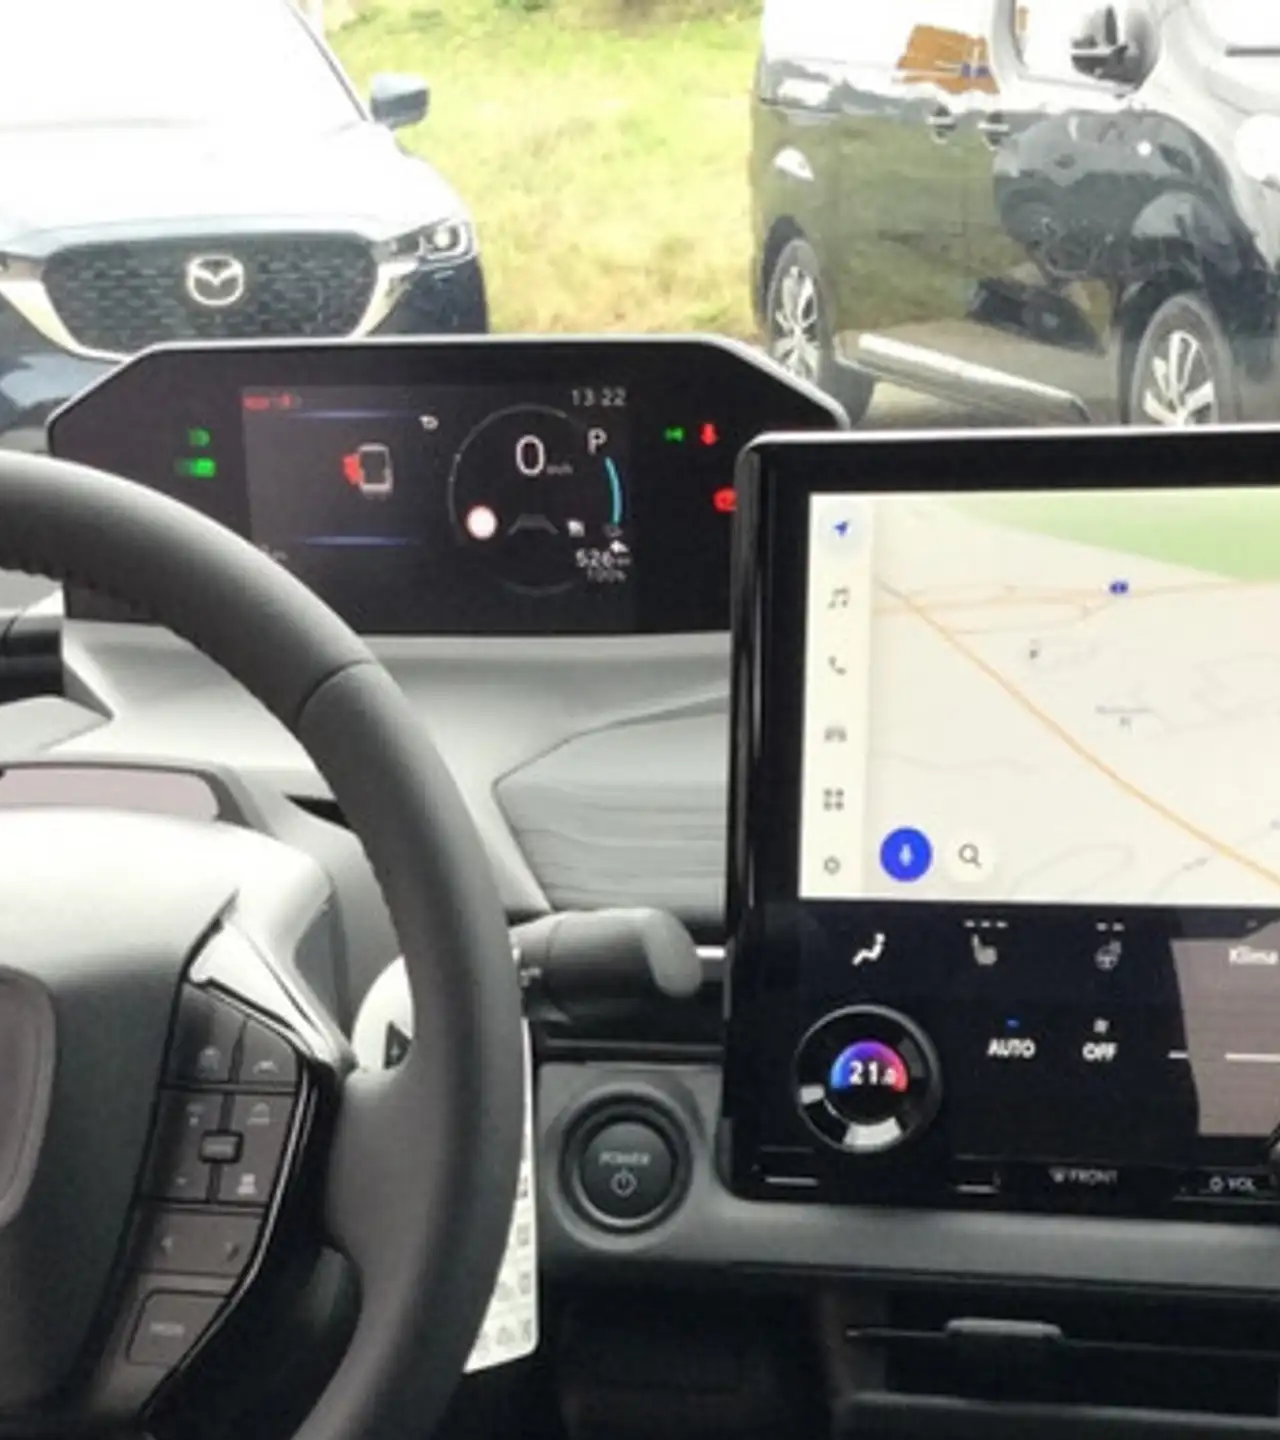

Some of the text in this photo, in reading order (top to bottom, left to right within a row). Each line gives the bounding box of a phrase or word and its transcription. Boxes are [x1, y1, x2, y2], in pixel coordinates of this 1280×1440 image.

[586, 427, 608, 455] P
[515, 434, 545, 477] 0
[1228, 946, 1279, 966] Klima
[986, 1038, 1037, 1059] AUTO
[1081, 1042, 1118, 1062] OFF
